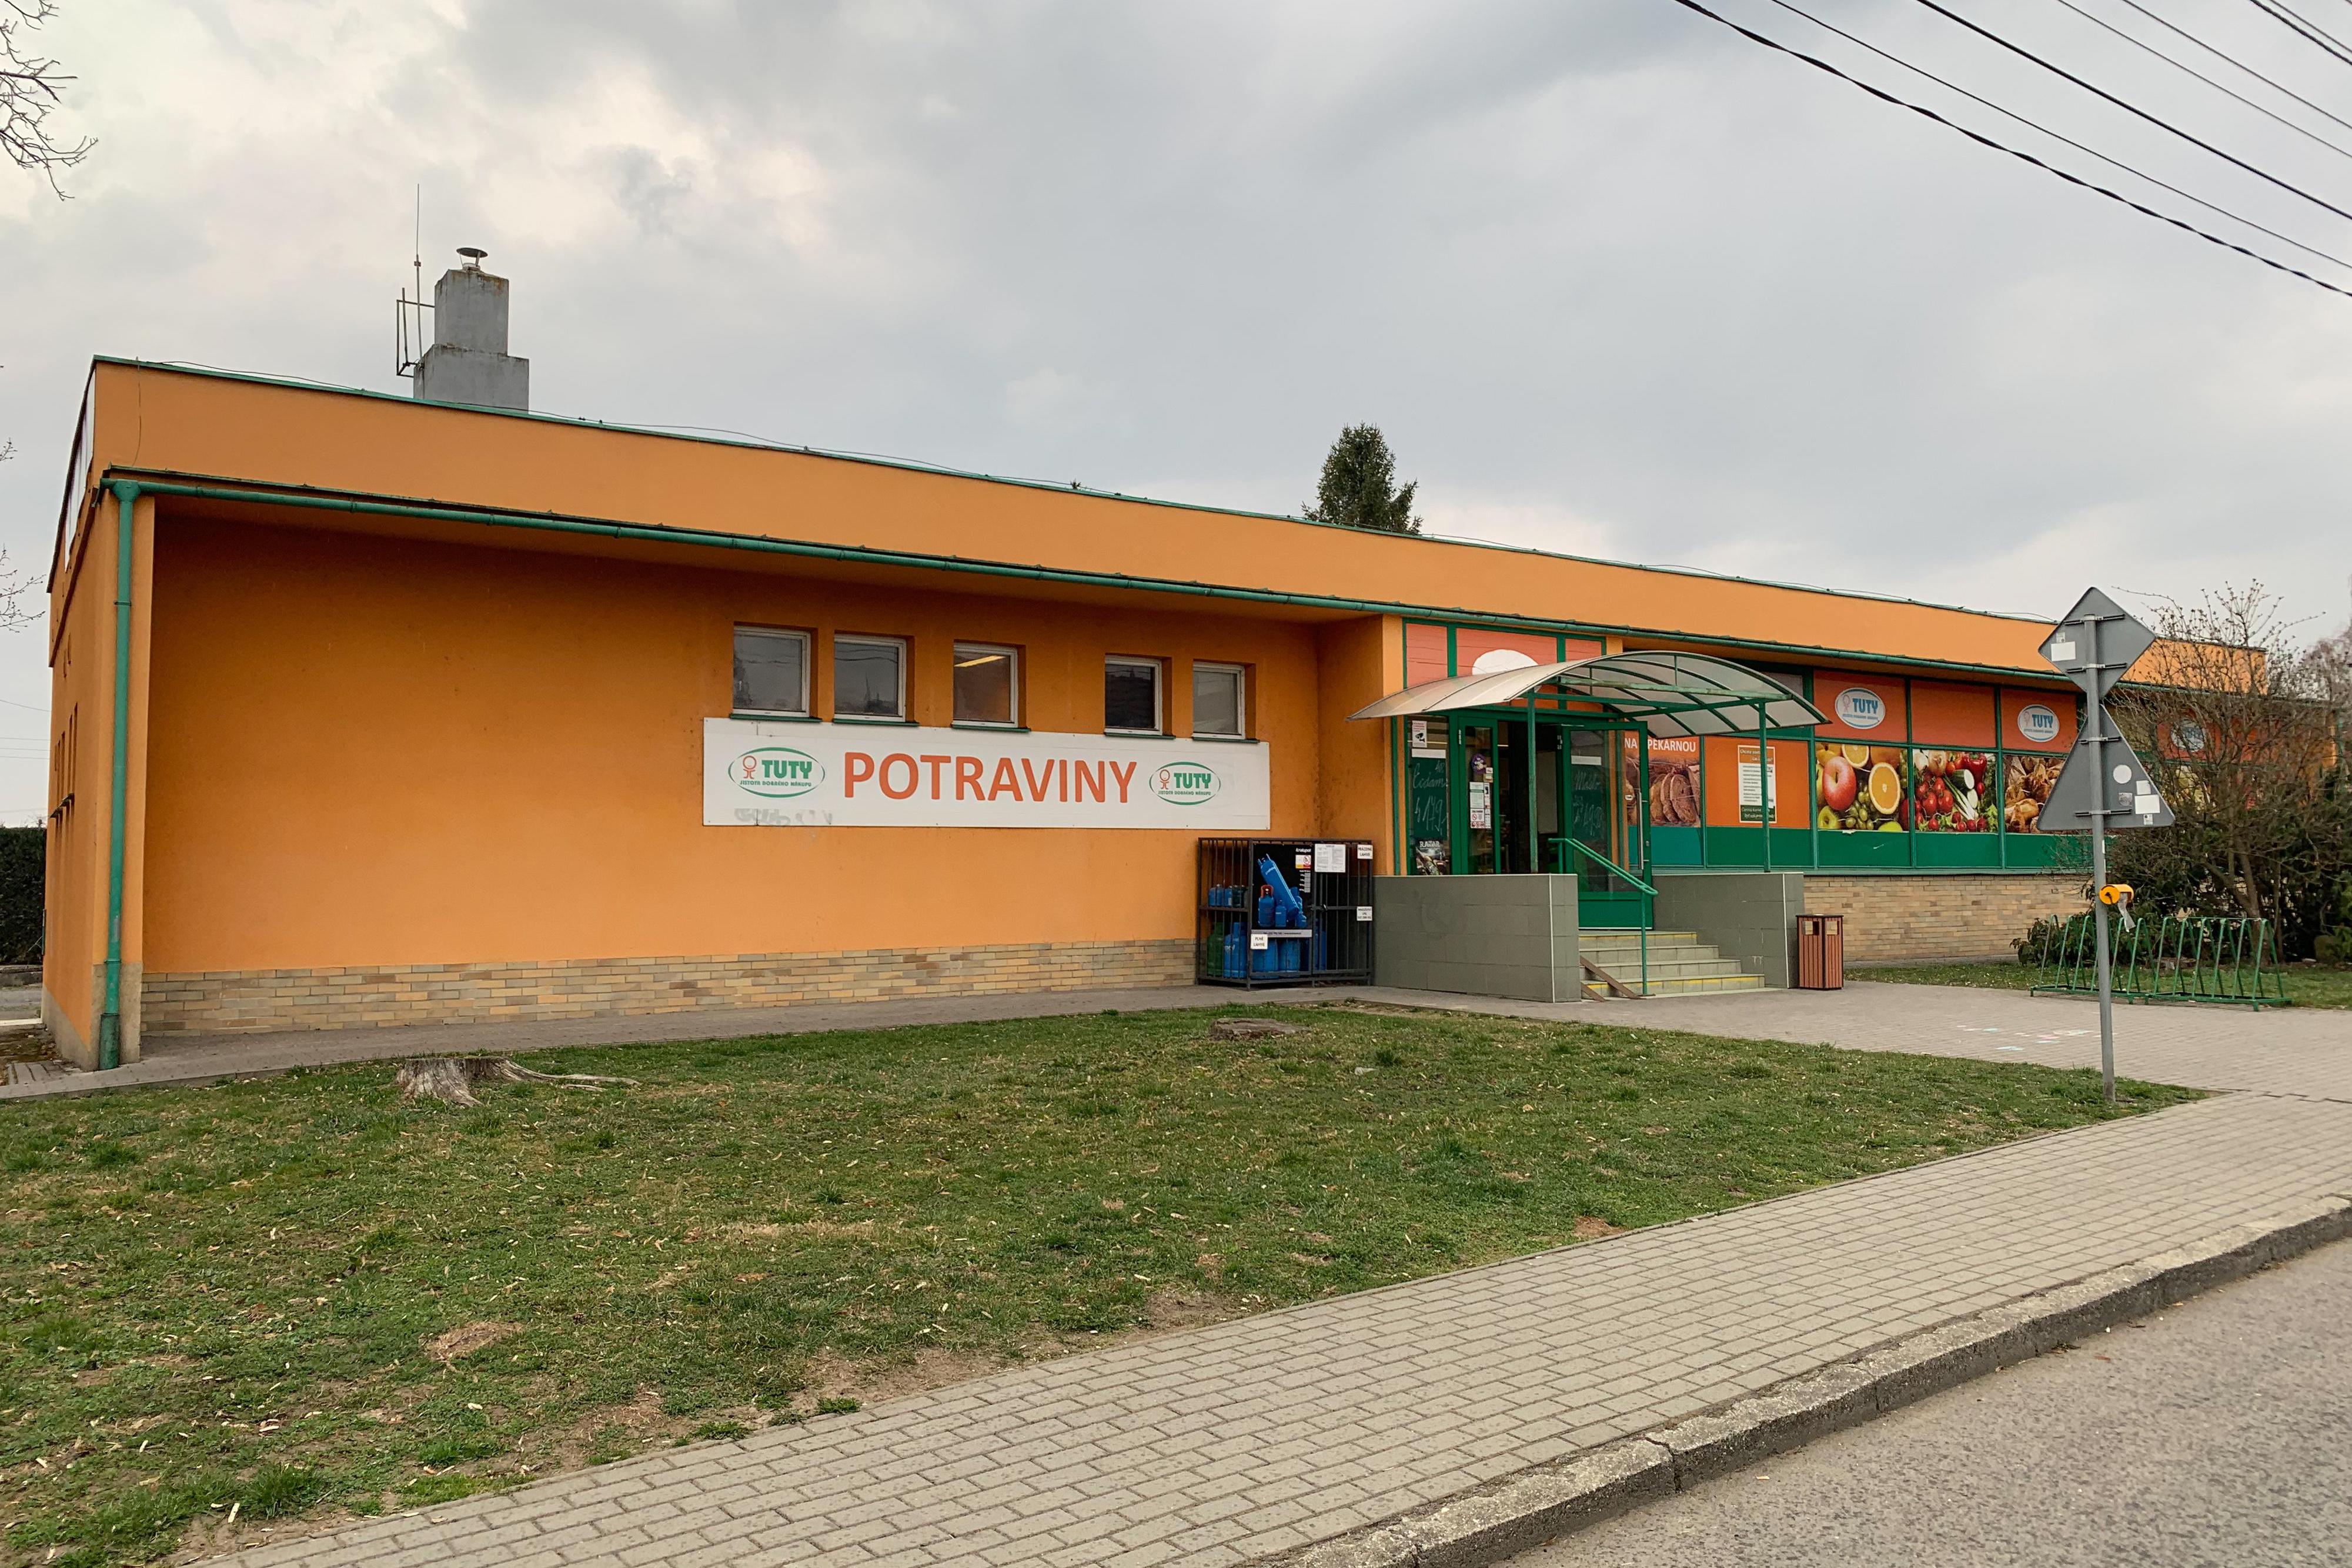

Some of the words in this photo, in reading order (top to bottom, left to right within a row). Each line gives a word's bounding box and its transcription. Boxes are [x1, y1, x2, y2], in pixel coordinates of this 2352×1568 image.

[1853, 698, 1878, 714] TUTY
[2032, 714, 2053, 728] TUTY
[1648, 738, 1696, 752] PEKÁRNOU
[761, 760, 812, 779] TUTY
[844, 752, 1137, 803] POTRAVINY
[1174, 773, 1211, 788] TUTY
